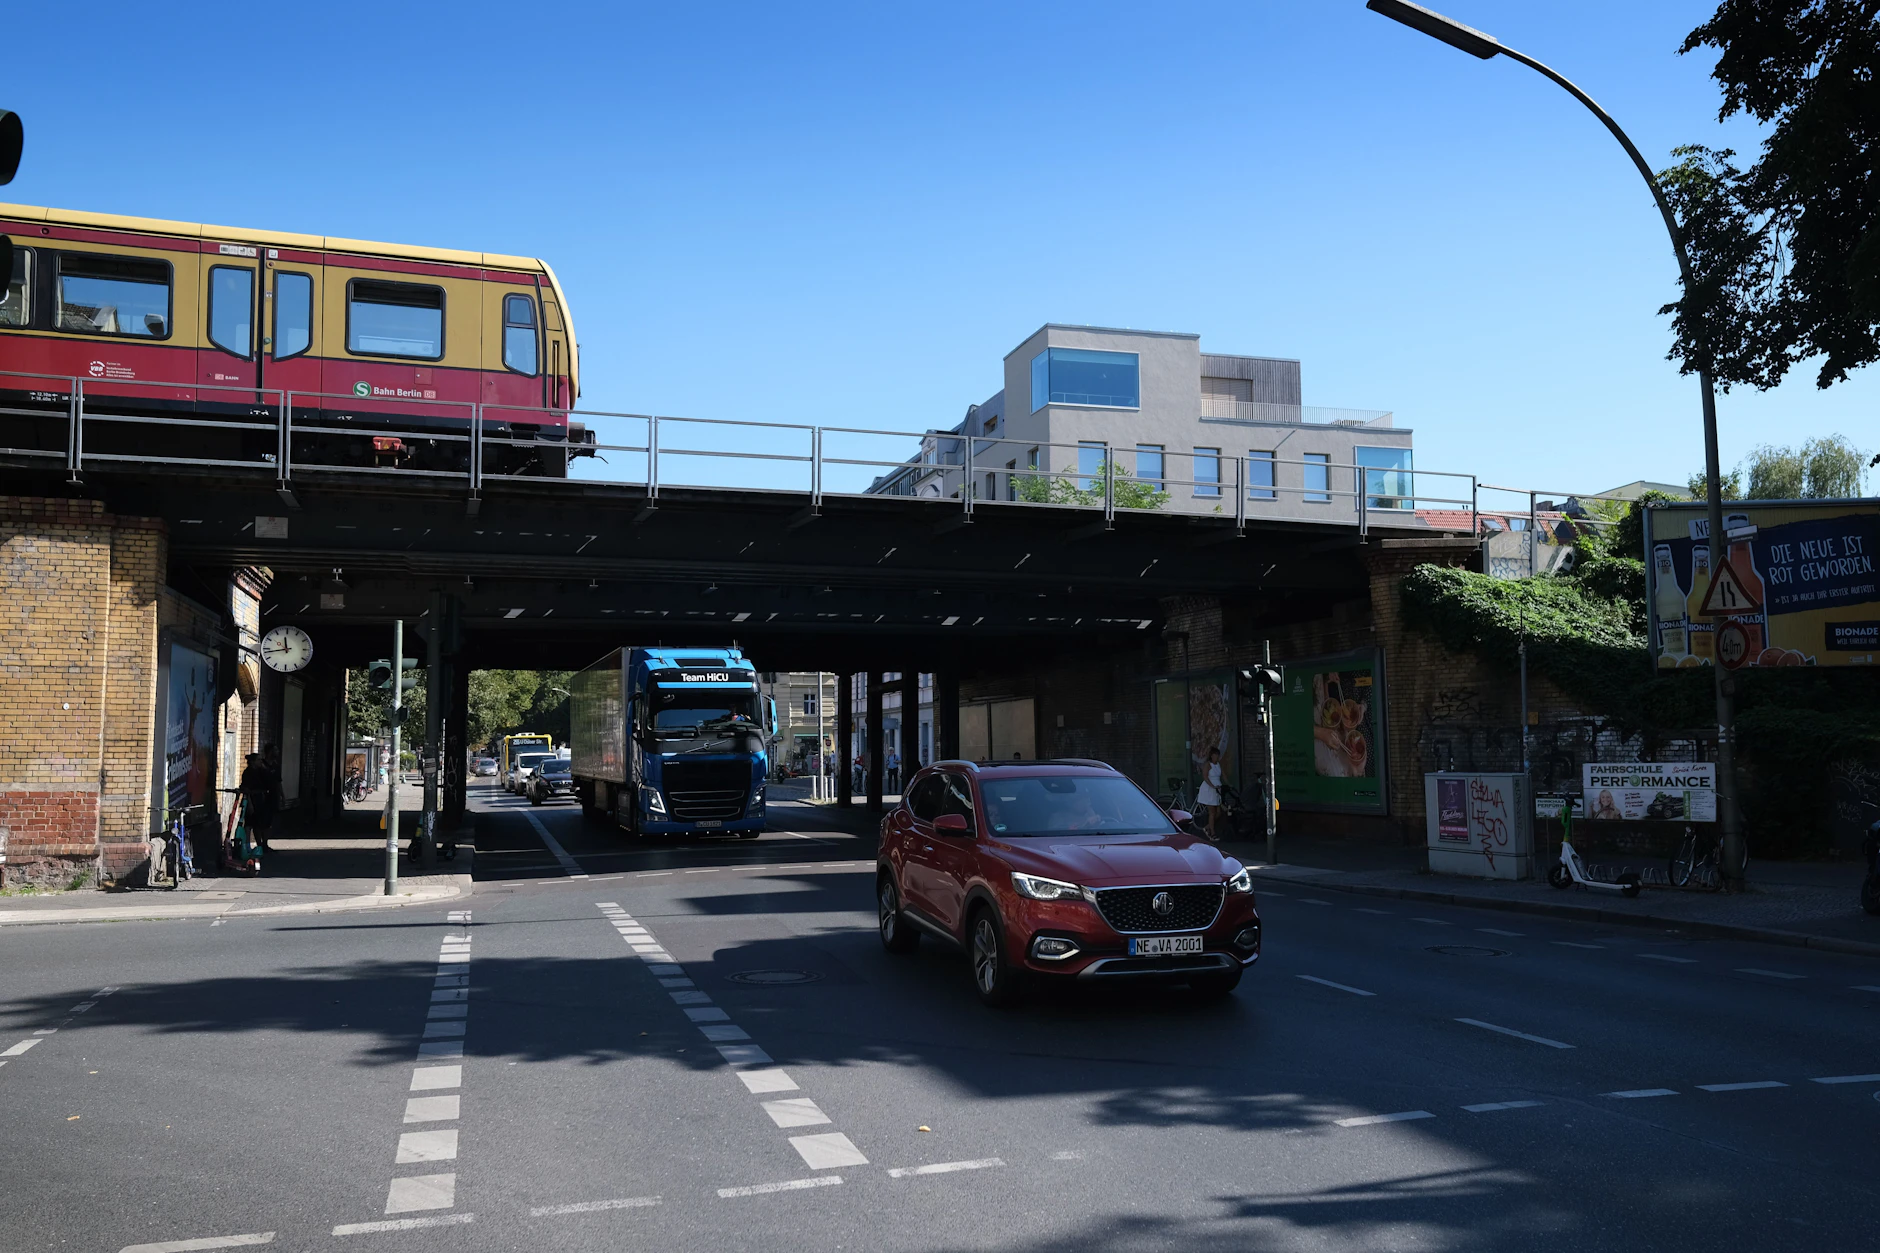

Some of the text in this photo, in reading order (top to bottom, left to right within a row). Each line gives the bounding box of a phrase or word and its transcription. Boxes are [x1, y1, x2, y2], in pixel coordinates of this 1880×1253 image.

[356, 382, 369, 396] S
[373, 386, 395, 396] Bahn
[396, 387, 422, 397] Berlin
[1770, 535, 1863, 564] DIE NEUE IST
[1768, 556, 1876, 585] ROT GEWORDEN.
[1781, 595, 1789, 604] IST
[1792, 594, 1799, 603] JA
[1800, 592, 1815, 602] AUCH
[1817, 591, 1827, 600] IHR
[1829, 588, 1849, 598] ERSTER
[1835, 627, 1879, 636] BIONADE
[681, 673, 729, 682] Team HiCU
[1590, 765, 1663, 774] FAHRSCHULE
[1590, 775, 1711, 788] PERFORMANCE
[1136, 939, 1150, 953] NE
[1158, 938, 1172, 952] VA
[1175, 937, 1202, 951] 2001
